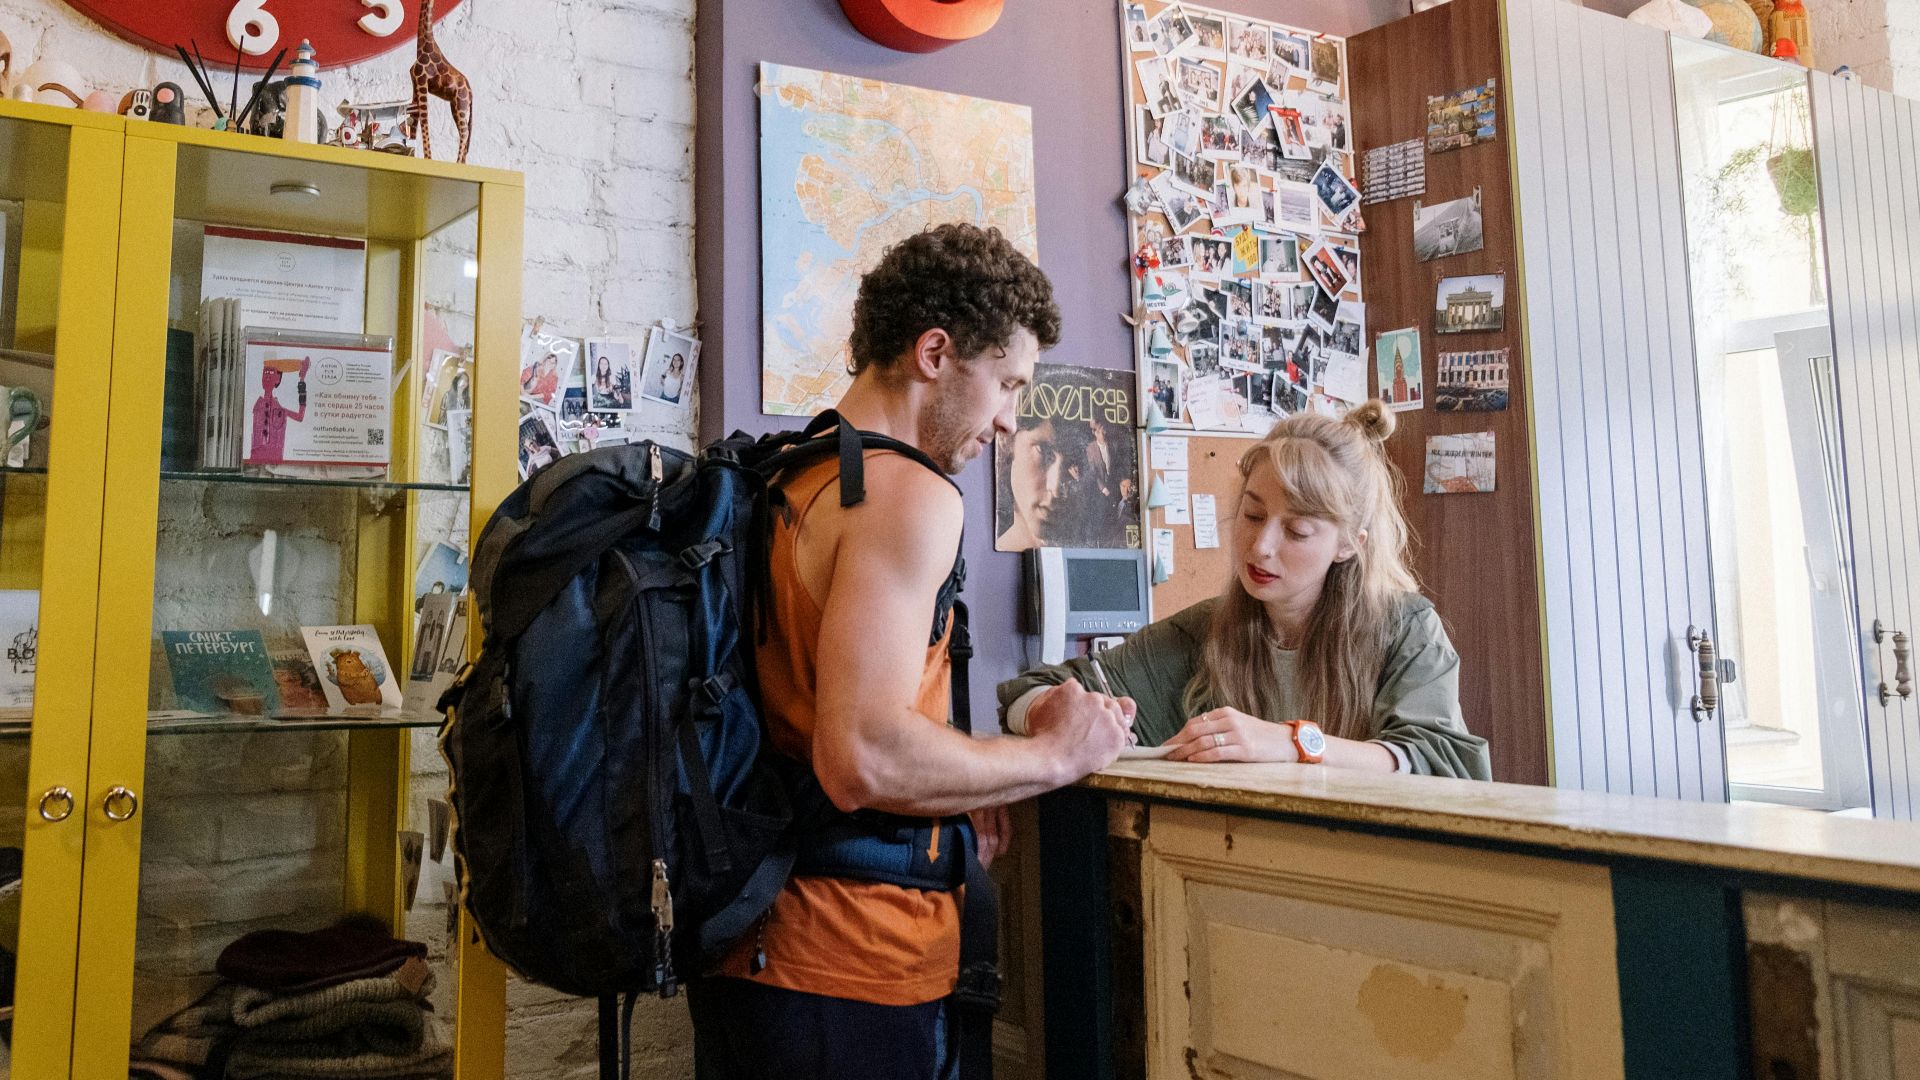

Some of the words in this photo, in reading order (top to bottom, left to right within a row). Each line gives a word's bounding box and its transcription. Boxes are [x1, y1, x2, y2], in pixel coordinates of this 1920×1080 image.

[226, 0, 280, 56] 6
[333, 392, 359, 401] обниму
[327, 402, 353, 411] сердце
[354, 402, 362, 410] 25
[364, 403, 385, 411] часов
[188, 631, 237, 643] САНКТ-
[175, 641, 256, 655] ПЕТЕРБУРГ
